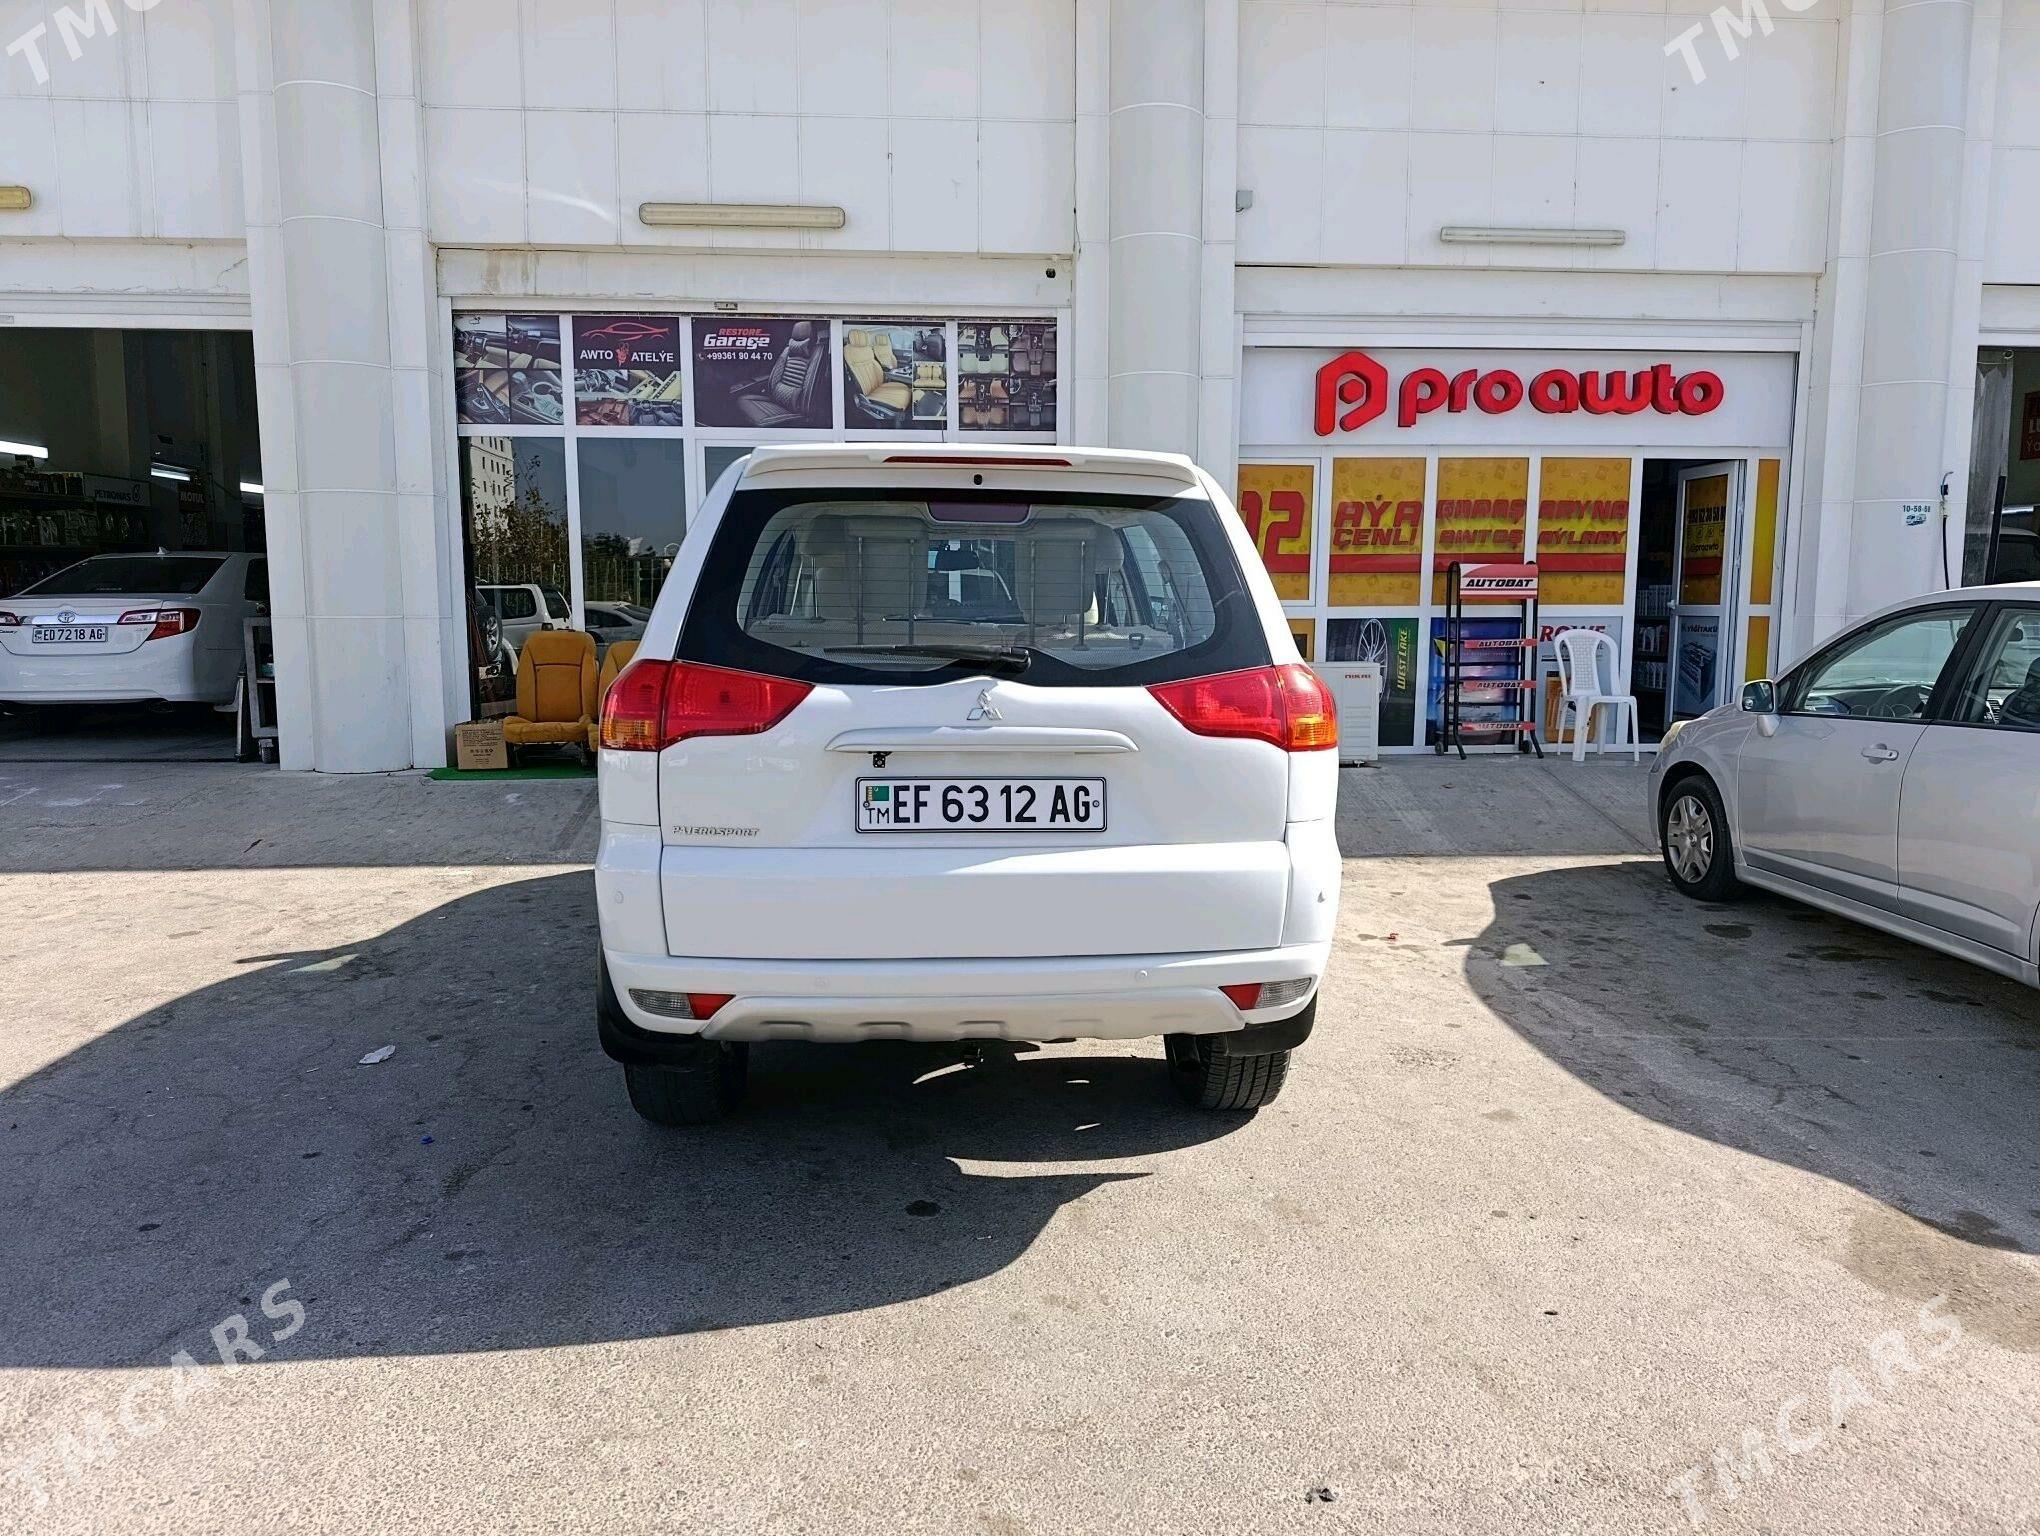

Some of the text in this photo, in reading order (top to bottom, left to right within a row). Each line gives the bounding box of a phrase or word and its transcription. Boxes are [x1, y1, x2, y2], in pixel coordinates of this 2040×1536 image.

[718, 328, 764, 336] RESTORE
[703, 333, 770, 350] Garage
[580, 349, 614, 360] AWTO
[706, 351, 773, 361] +99361 90 44 70
[1465, 578, 1534, 588] AUTOBAT
[43, 629, 56, 641] ED
[58, 629, 73, 641] 72
[74, 629, 86, 641] 18
[88, 628, 103, 640] AG
[1478, 639, 1525, 648] AUTOBAT
[1476, 681, 1523, 689] AUTOBAT
[865, 784, 1091, 824] TM EF 63 12 AG
